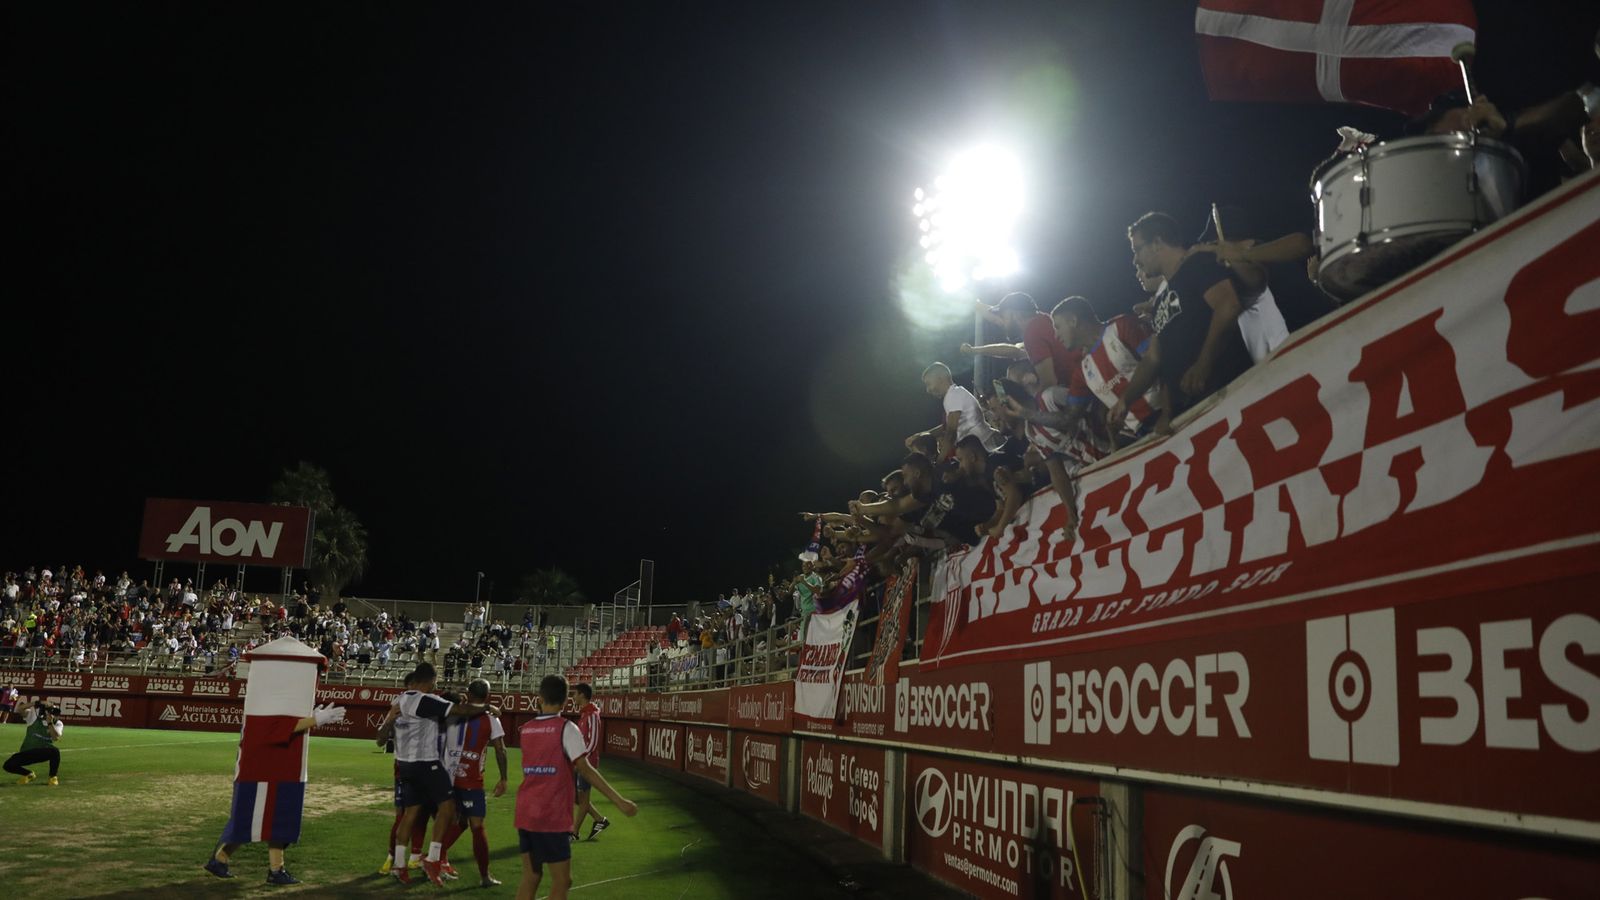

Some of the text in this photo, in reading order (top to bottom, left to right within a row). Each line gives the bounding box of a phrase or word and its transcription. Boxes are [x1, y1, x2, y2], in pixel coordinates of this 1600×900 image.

[1031, 561, 1294, 634] GRADA ACF FONDO SUR
[44, 679, 82, 687] APOLO
[91, 681, 129, 689] APOLO
[146, 683, 184, 691] APOLO
[193, 685, 230, 693] APOLO
[1056, 651, 1252, 738] BESOCCER
[181, 713, 216, 723] AGUA
[182, 705, 218, 713] Materiales
[910, 682, 990, 731] BESOCCER
[648, 728, 677, 761] NACEX
[857, 722, 877, 736] queremos
[877, 724, 885, 736] ver
[840, 753, 879, 791] El Cerezo
[849, 786, 867, 824] Rojo
[953, 771, 1074, 852] HYUNDAI
[944, 852, 1018, 897] ventas@permotor.com
